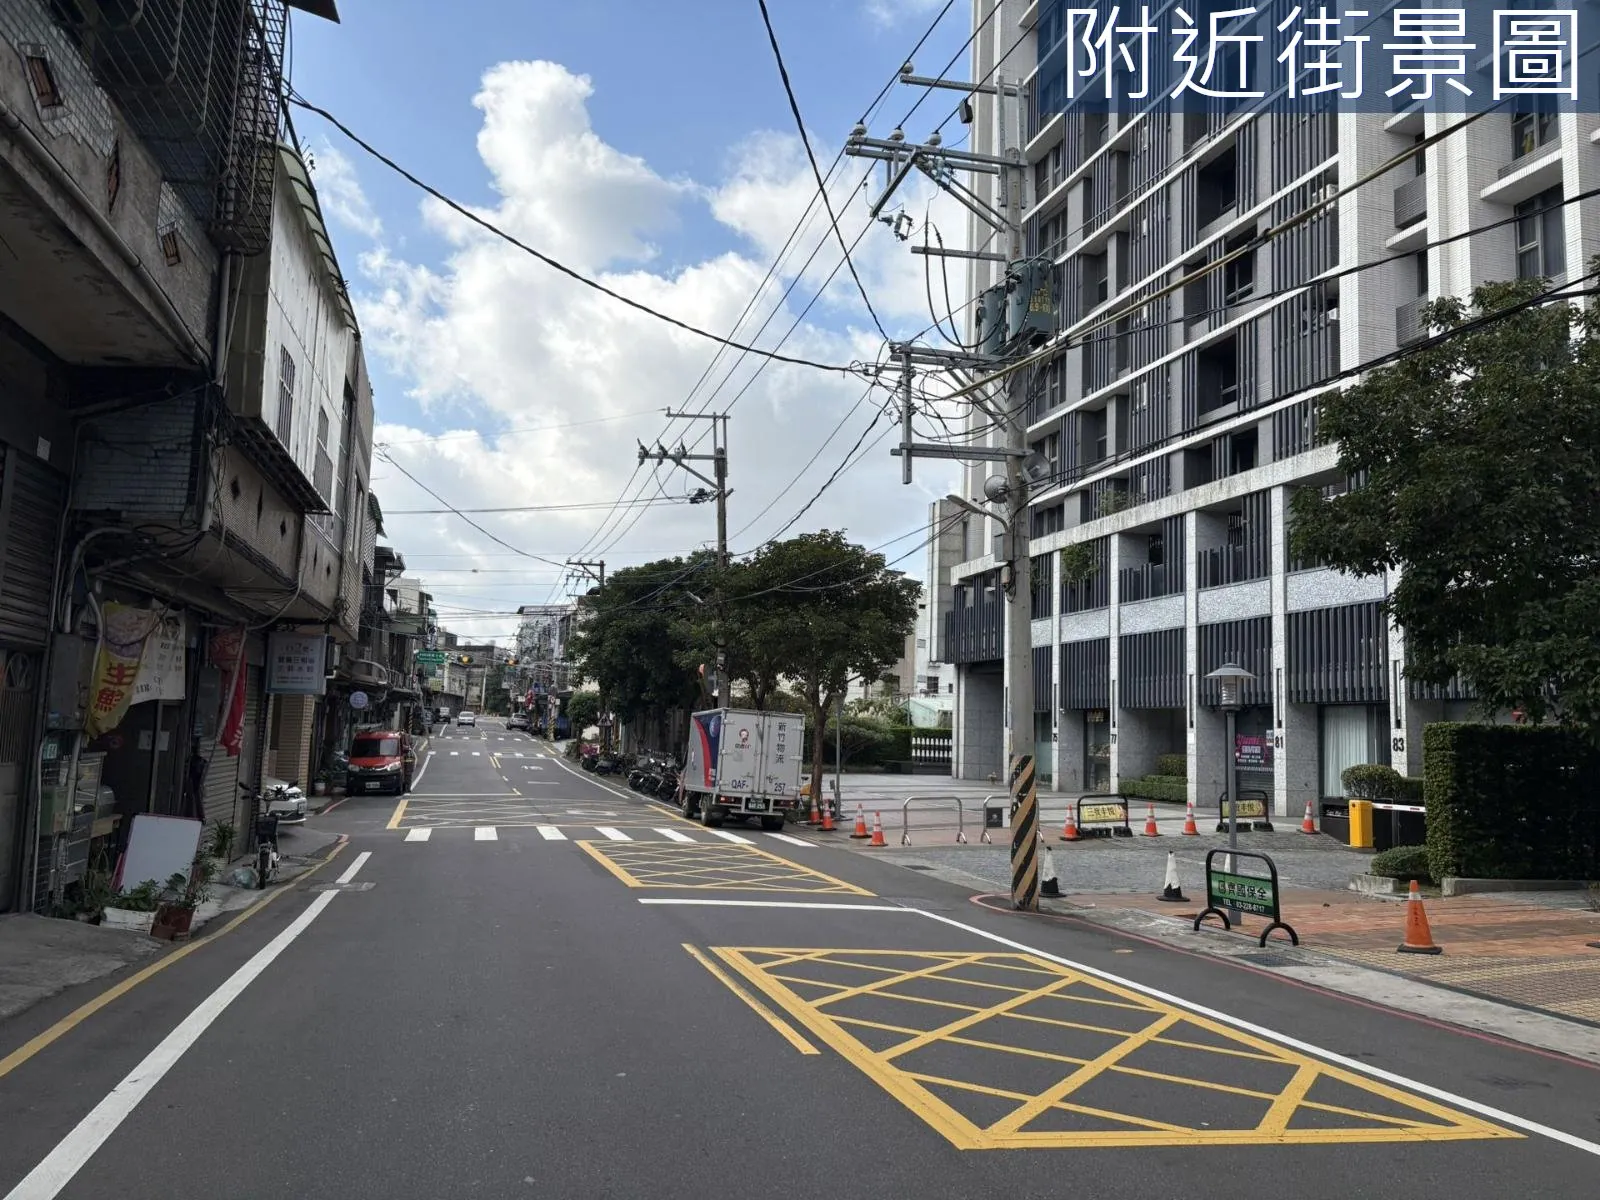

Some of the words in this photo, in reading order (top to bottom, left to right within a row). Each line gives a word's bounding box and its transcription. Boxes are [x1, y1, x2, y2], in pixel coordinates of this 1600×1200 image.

[775, 722, 787, 764] 新竹物流
[1111, 734, 1117, 744] 77
[1274, 737, 1284, 749] 81
[1392, 737, 1405, 752] 83
